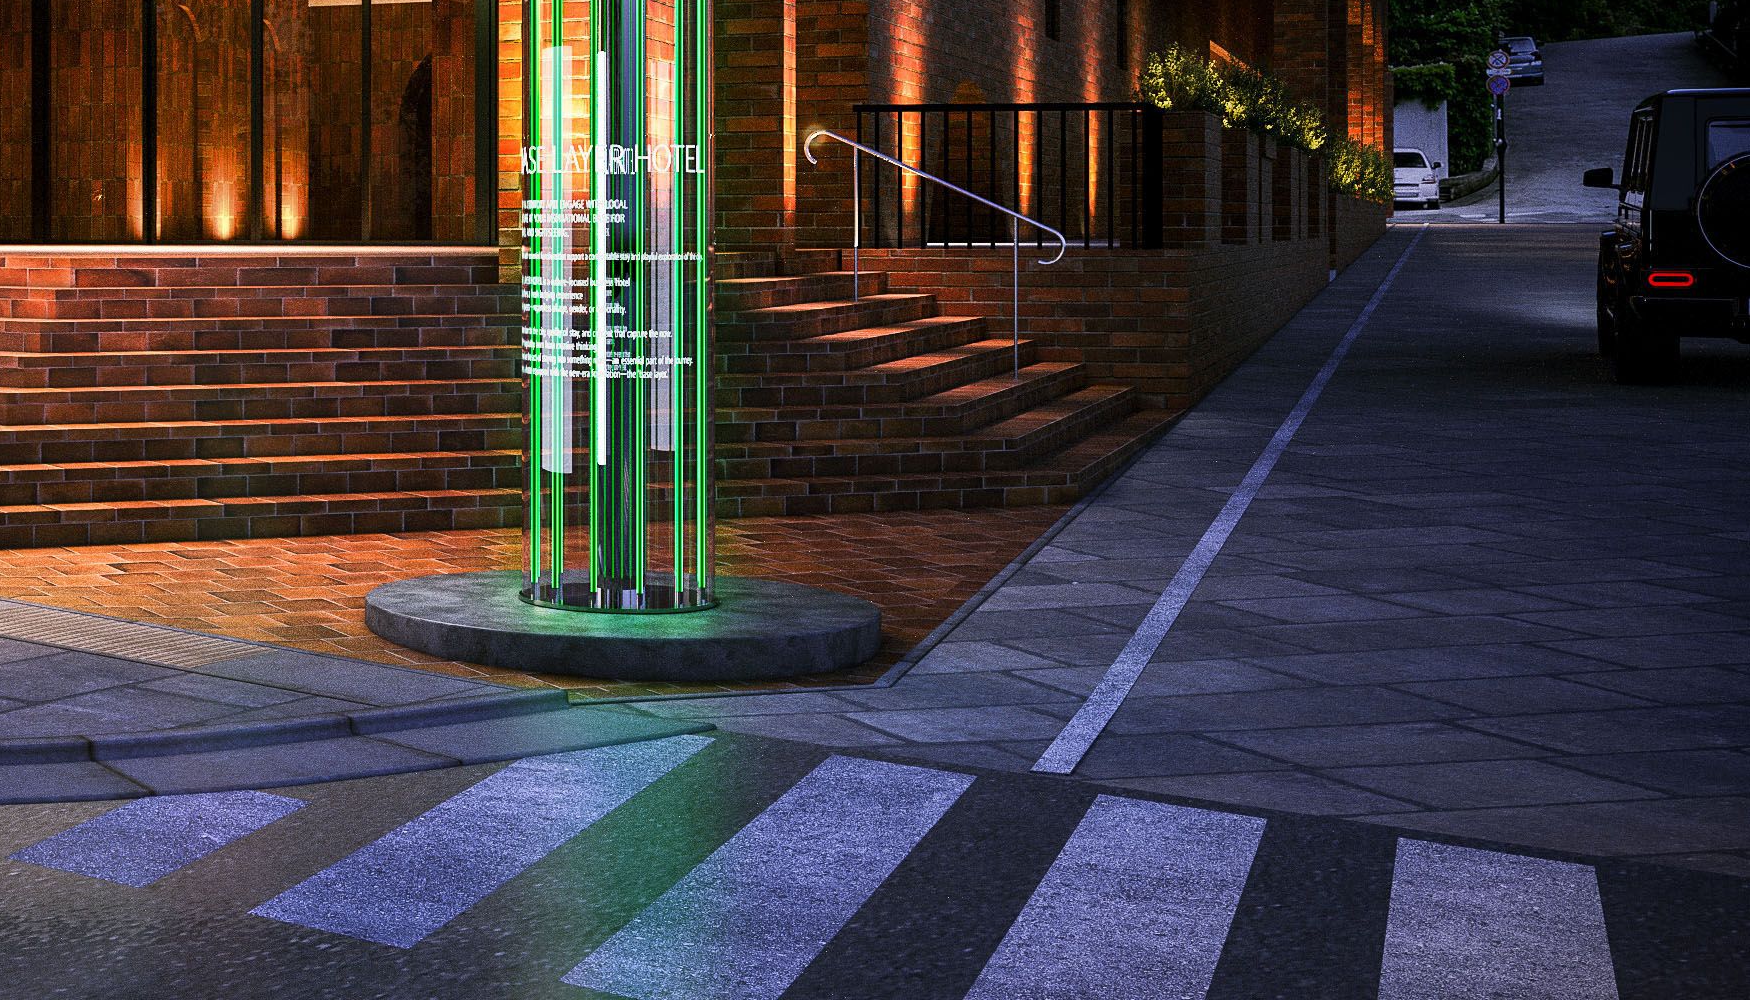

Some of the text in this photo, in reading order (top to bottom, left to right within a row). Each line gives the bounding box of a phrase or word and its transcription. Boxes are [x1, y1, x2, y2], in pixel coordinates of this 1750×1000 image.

[635, 144, 705, 174] HOTEL
[586, 199, 606, 209] WIT
[605, 199, 628, 209] LOCAL
[611, 213, 626, 223] FOR
[627, 330, 648, 340] capture
[645, 357, 657, 367] part
